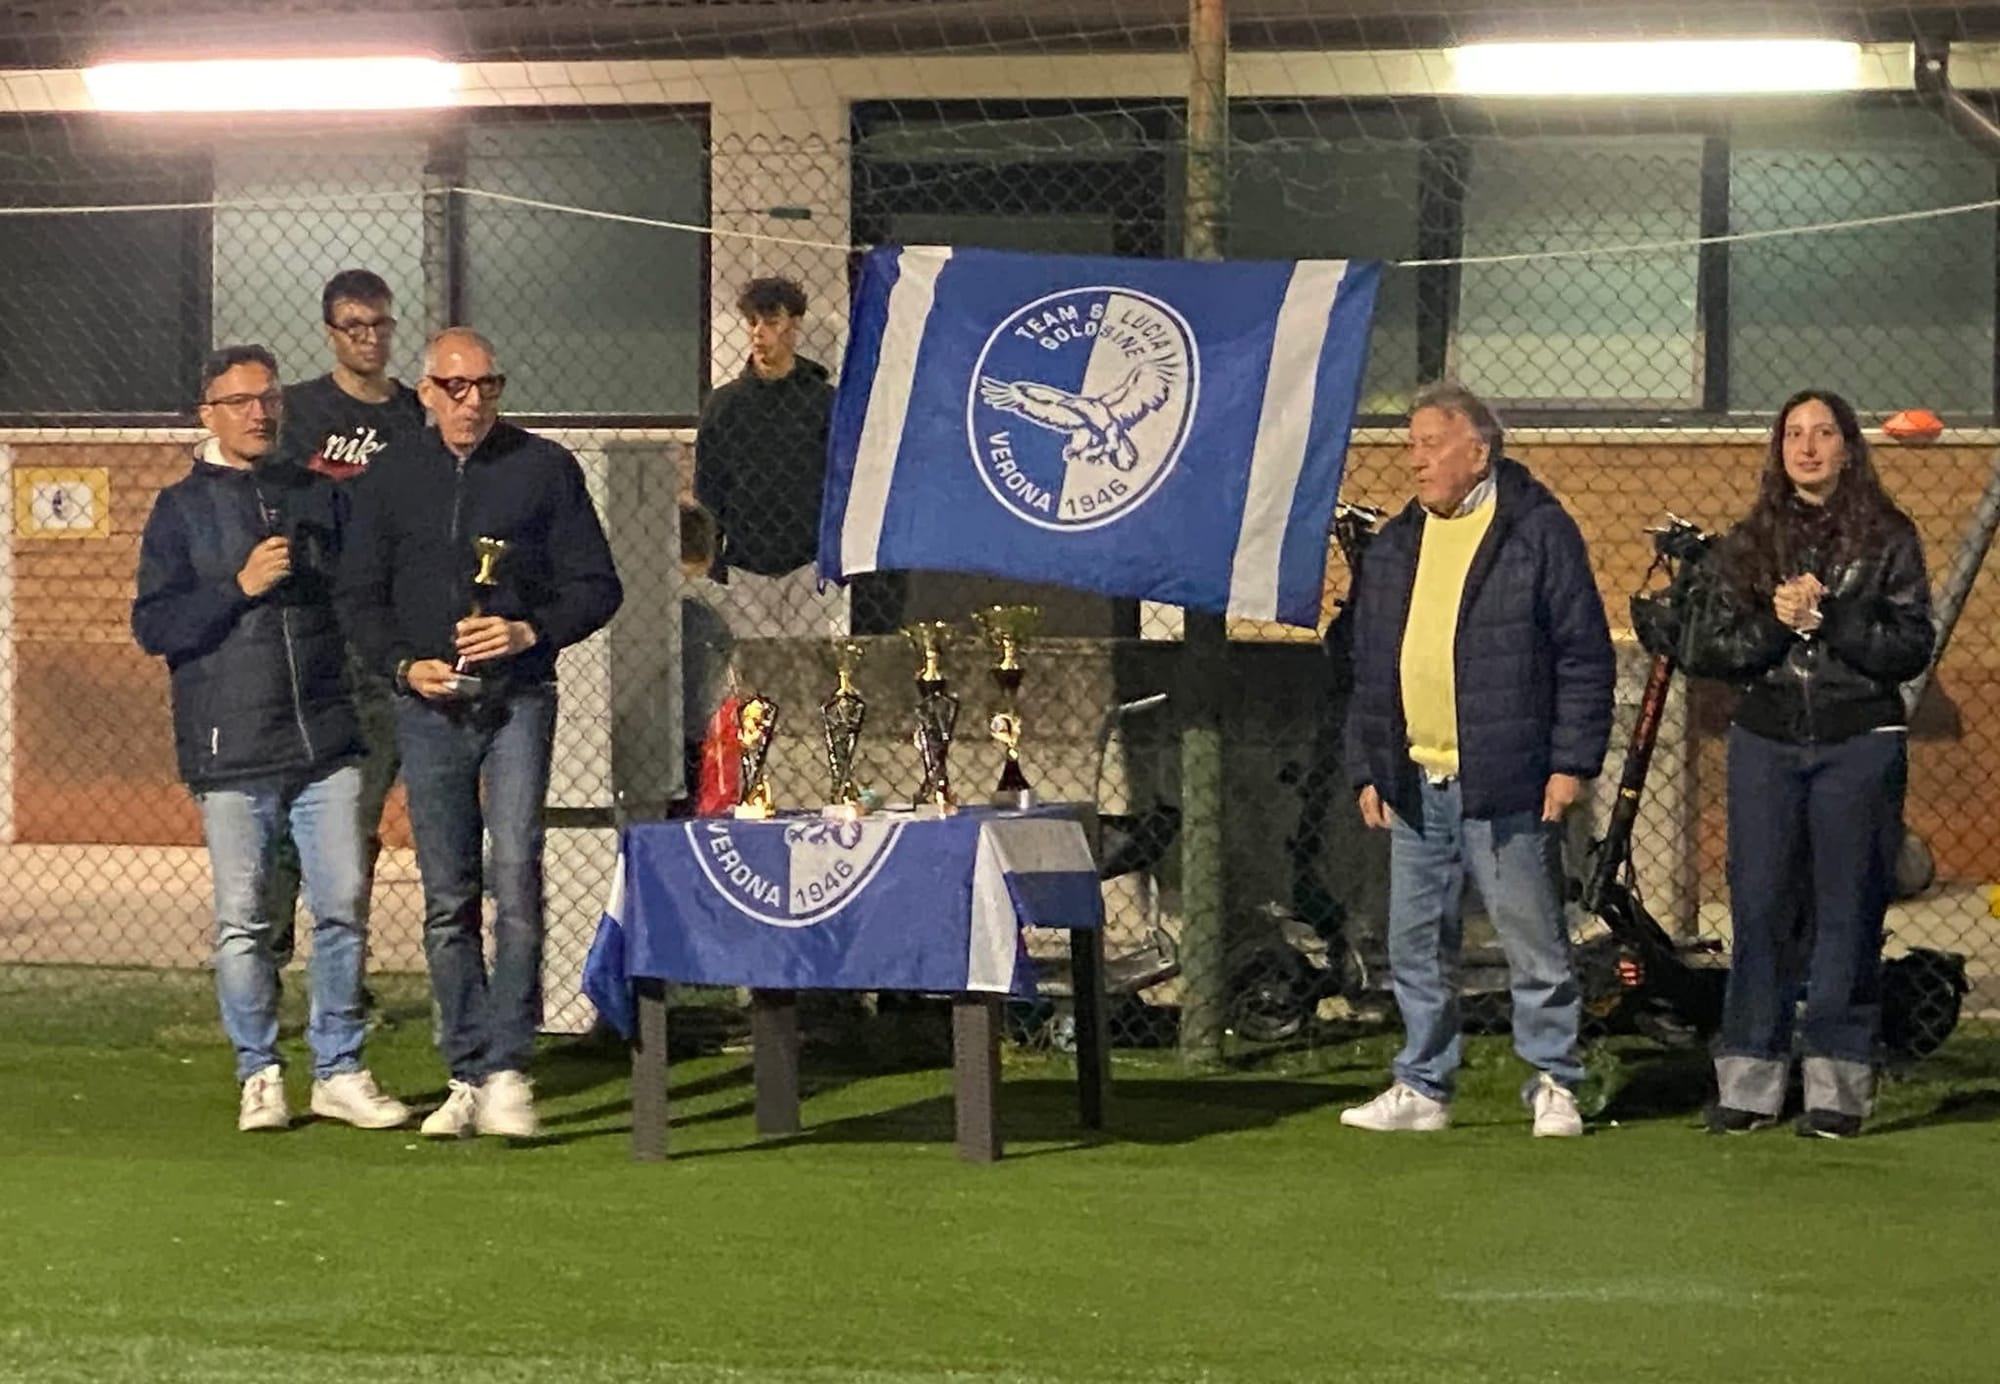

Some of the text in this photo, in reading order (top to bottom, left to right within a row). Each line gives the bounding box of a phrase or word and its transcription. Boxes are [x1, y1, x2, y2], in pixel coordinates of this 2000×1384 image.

[1015, 304, 1079, 340] TEAM
[1120, 309, 1172, 351] LUCIA
[989, 431, 1051, 512] VERONA
[1065, 478, 1128, 516] 1946
[707, 822, 782, 908] VERONA
[795, 859, 854, 908] 1946
